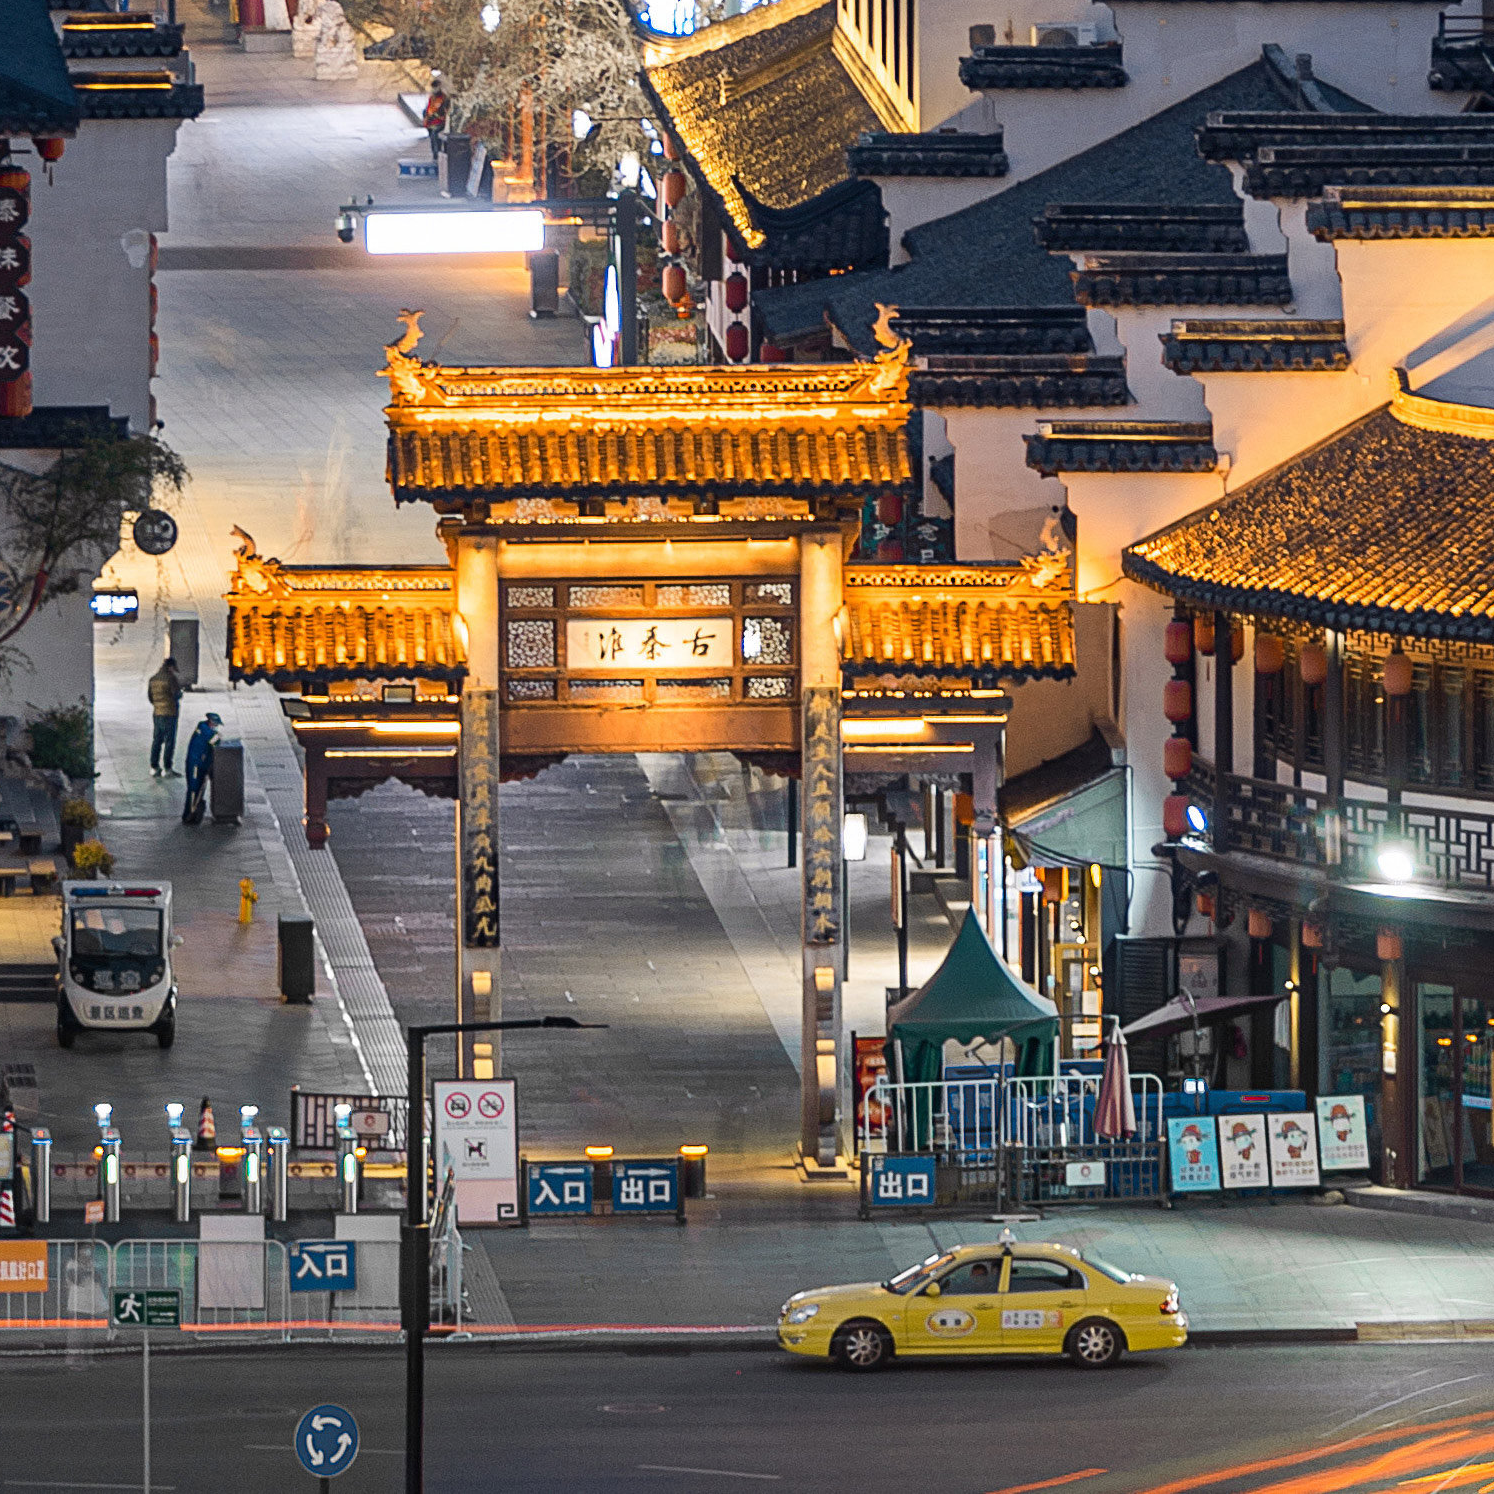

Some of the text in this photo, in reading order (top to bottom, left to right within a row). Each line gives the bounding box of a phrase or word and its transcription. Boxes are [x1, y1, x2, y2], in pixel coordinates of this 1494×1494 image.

[599, 626, 716, 661] 古秦淮
[535, 1179, 586, 1205] 入口
[620, 1177, 671, 1204] 出口
[879, 1170, 929, 1198] 出口
[296, 1252, 348, 1278] 入口
